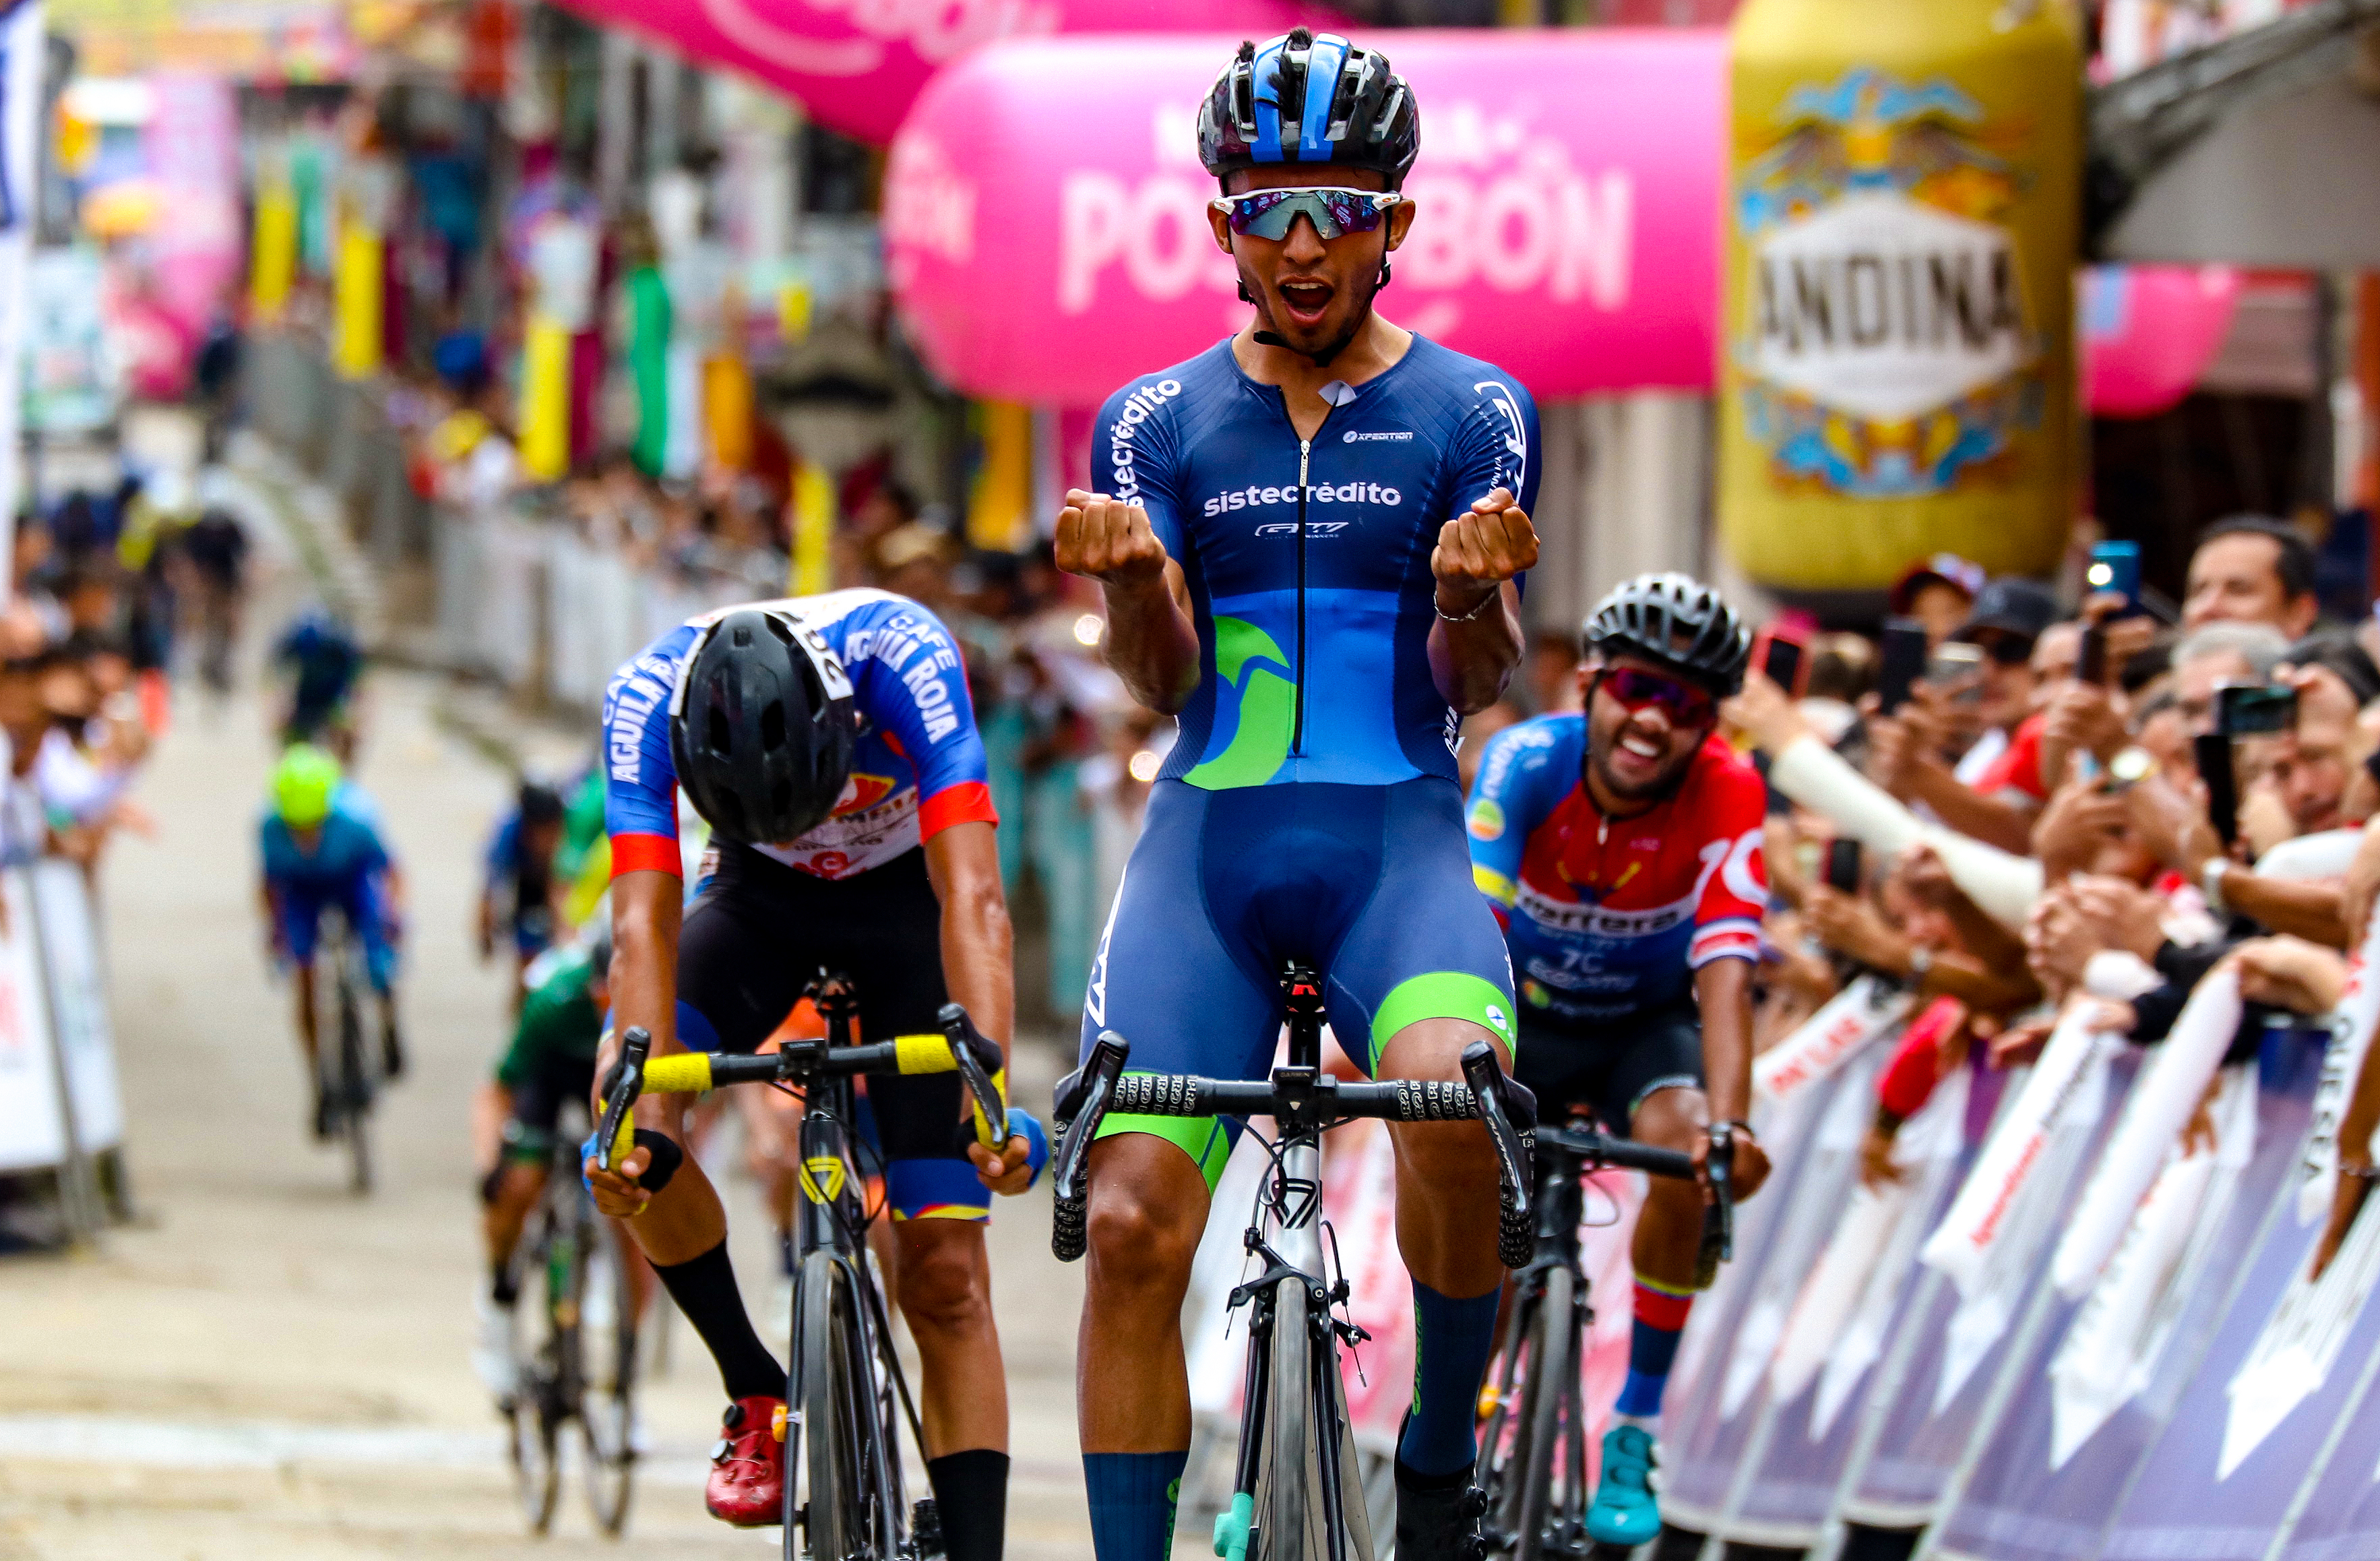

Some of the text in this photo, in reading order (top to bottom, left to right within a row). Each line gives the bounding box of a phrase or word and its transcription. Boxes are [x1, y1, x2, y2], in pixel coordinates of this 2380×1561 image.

[1058, 138, 1634, 315] POBÓN
[1760, 248, 2020, 355] ANDINA
[1203, 482, 1402, 518] sistecrédito
[902, 656, 958, 745] ROJA
